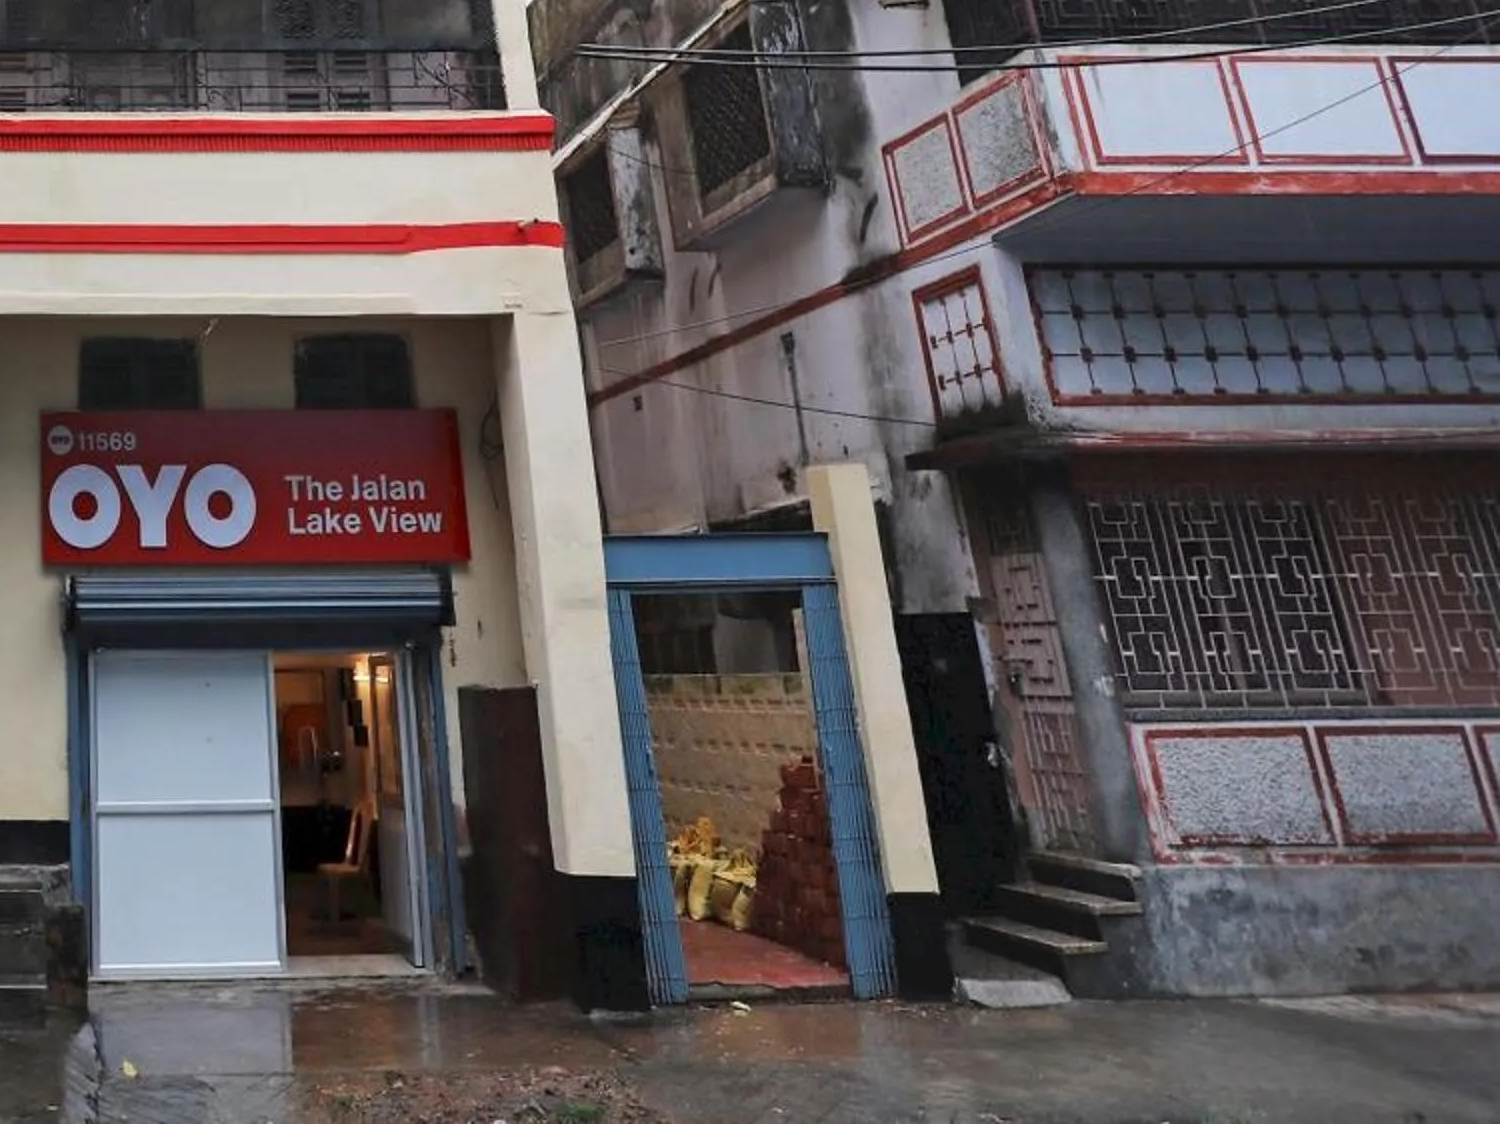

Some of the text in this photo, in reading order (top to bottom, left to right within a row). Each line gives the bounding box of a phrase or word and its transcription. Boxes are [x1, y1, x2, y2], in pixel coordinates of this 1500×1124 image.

[79, 431, 137, 452] 11569
[285, 474, 426, 502] The Jalan
[48, 462, 257, 549] OYO
[288, 507, 443, 535] Lake View
